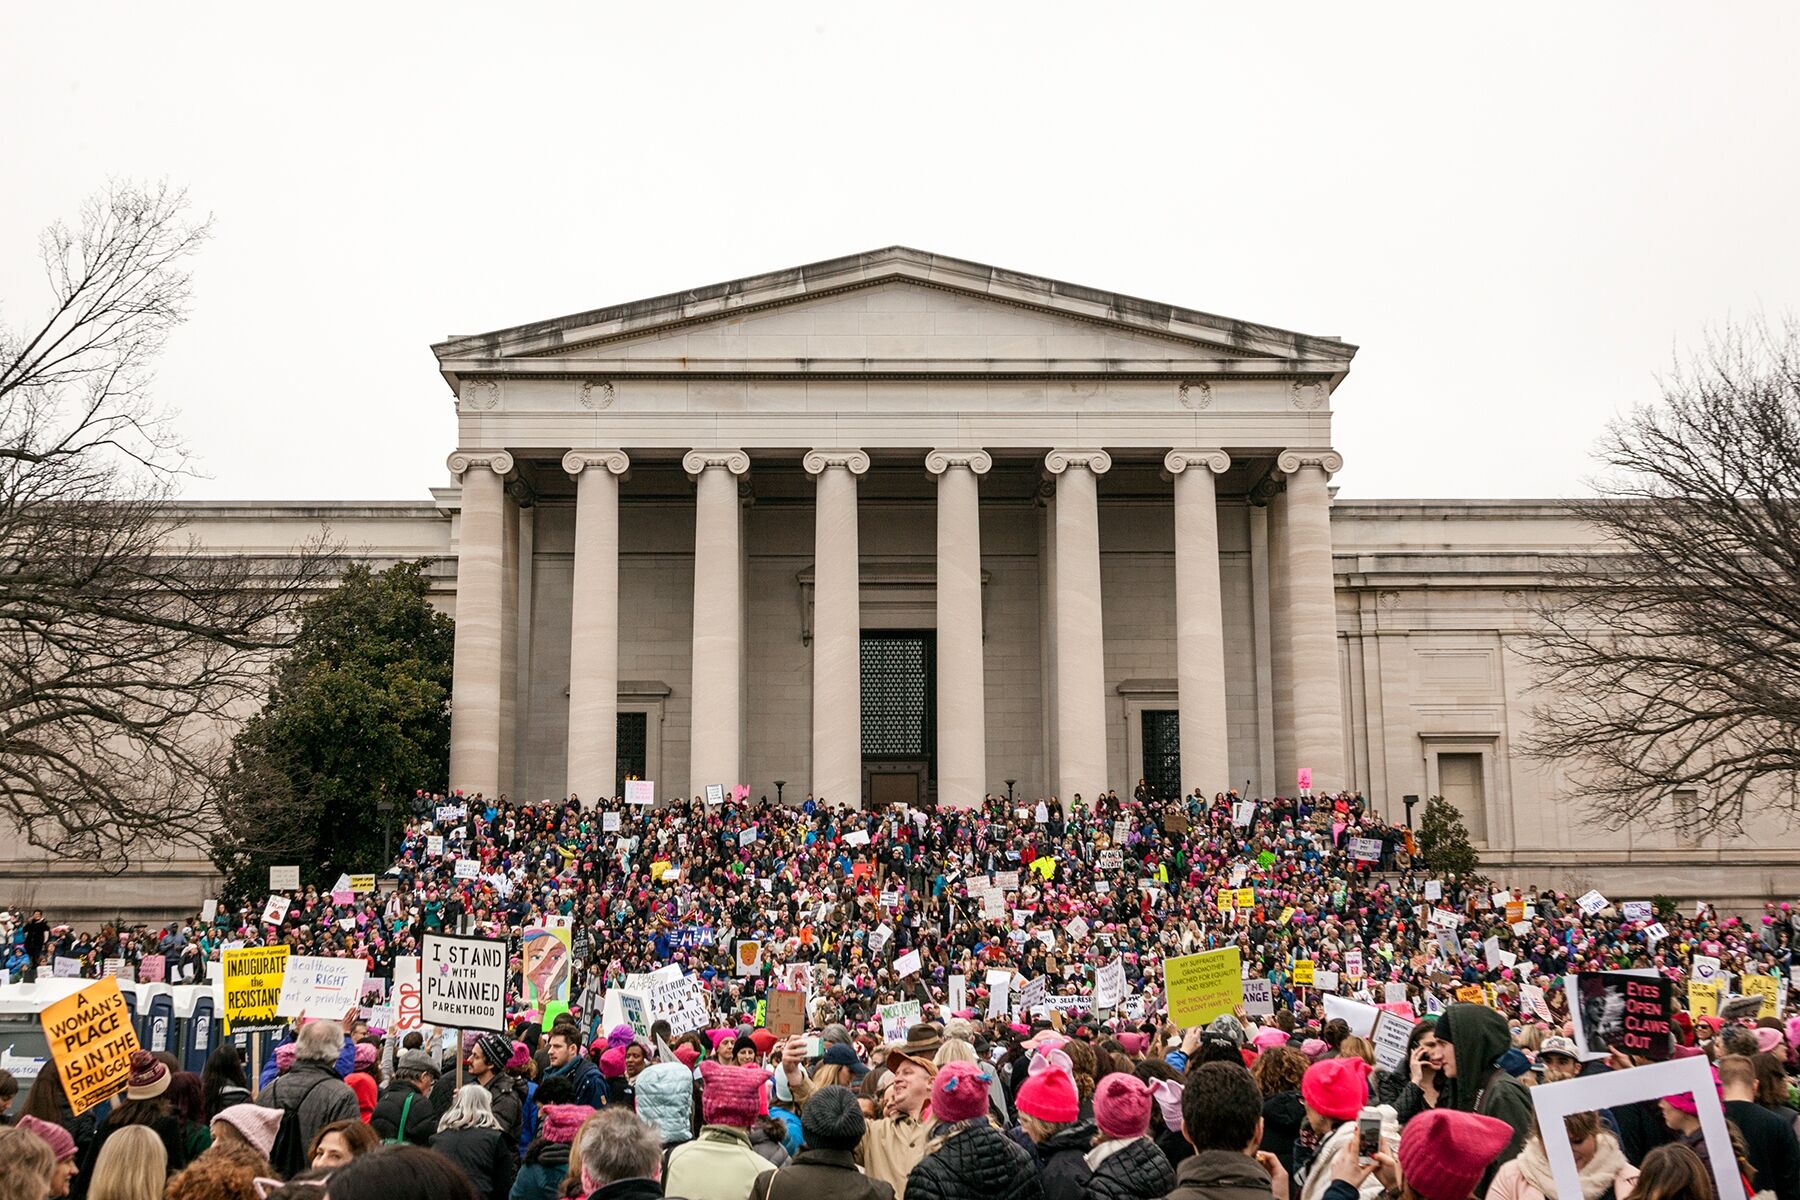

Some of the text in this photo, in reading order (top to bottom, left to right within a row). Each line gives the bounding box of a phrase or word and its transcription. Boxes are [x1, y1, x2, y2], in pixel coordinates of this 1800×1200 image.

[433, 943, 501, 968] I STAND
[228, 956, 286, 977] INAUGURATE
[292, 958, 345, 974] Healthcare
[452, 967, 477, 978] WITH
[250, 977, 263, 987] the
[315, 973, 348, 987] RIGHT
[659, 976, 693, 994] PLURIBUS
[1245, 982, 1264, 991] THE
[285, 991, 301, 1002] not
[428, 977, 500, 1002] PLANNED
[663, 989, 686, 1002] UNUM
[1243, 991, 1269, 1002] ANGE
[1627, 981, 1659, 998] EYES
[77, 993, 89, 1008] A
[228, 988, 281, 1009] RESISTANC
[398, 982, 422, 1029] STOP
[1626, 998, 1662, 1016] OPEN
[50, 994, 122, 1038] WOMAN'S
[432, 1000, 495, 1017] PARENTHOOD
[671, 1006, 705, 1023] OF MANY
[64, 1012, 120, 1053] PLACE
[672, 1025, 687, 1035] ONE
[1625, 1015, 1670, 1034] CLAWS
[1624, 1032, 1651, 1049] OUT
[65, 1032, 135, 1081] IS IN THE
